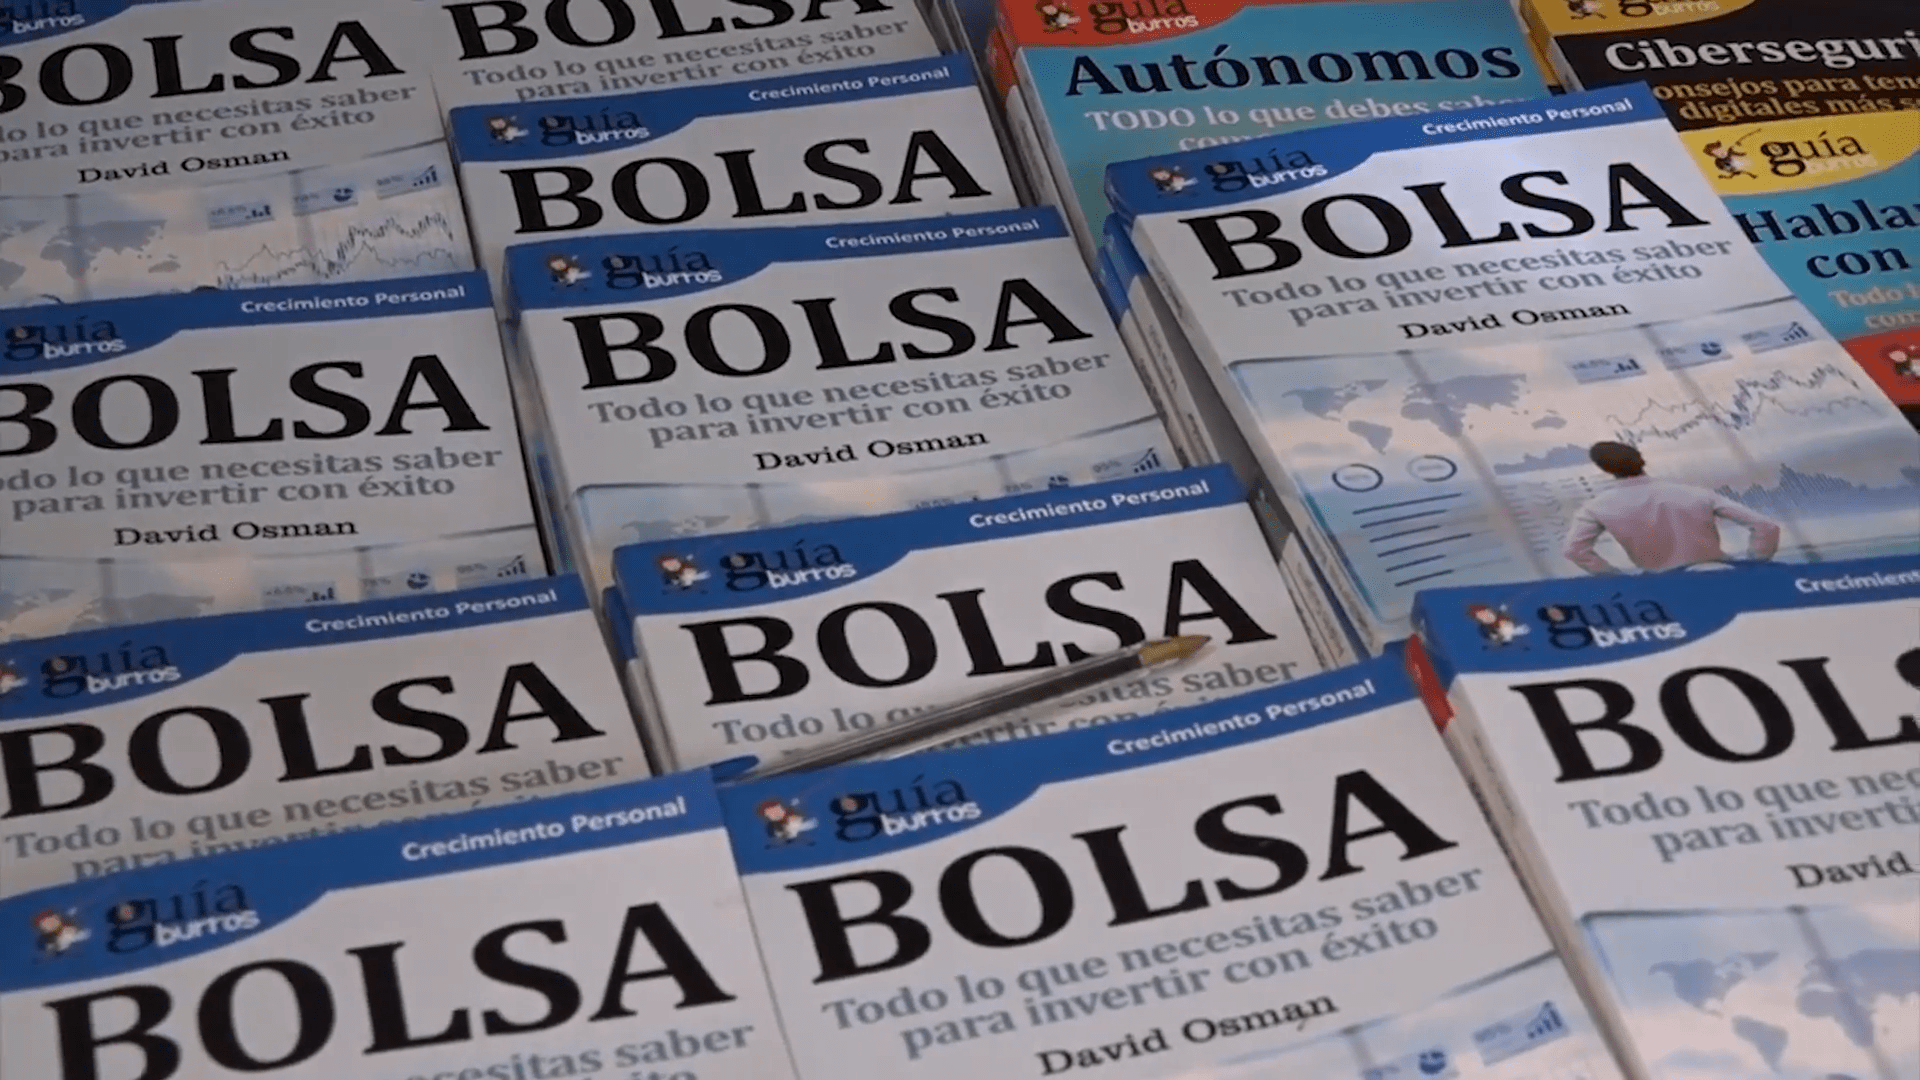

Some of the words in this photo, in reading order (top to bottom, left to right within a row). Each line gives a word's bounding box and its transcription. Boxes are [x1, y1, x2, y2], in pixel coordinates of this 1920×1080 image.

[12, 13, 85, 34] burros
[1126, 15, 1199, 34] burros
[0, 20, 405, 113] OLSA
[463, 68, 548, 88] Todo
[555, 60, 587, 78] lo
[600, 55, 656, 79] que
[664, 37, 811, 66] necesitas
[819, 18, 909, 44] saber
[515, 79, 591, 102] para
[600, 63, 724, 92] invertir
[732, 56, 790, 76] con
[798, 40, 876, 65] éxito
[1065, 44, 1521, 96] Autónomos
[1605, 30, 1920, 71] Ciberseguri
[748, 82, 863, 102] Crecimiento
[868, 66, 950, 89] Personal
[1653, 78, 1777, 100] onsejos
[1783, 76, 1861, 98] para
[1863, 74, 1920, 92] ten
[37, 121, 68, 140] lo
[78, 113, 144, 139] que
[152, 95, 302, 127] necesitas
[310, 84, 417, 112] saber
[79, 127, 212, 154] invertir
[220, 120, 282, 138] con
[291, 108, 374, 131] éxito
[1085, 109, 1196, 132] TODO
[1207, 105, 1239, 125] lo
[1249, 103, 1315, 128] que
[1324, 97, 1430, 121] debes
[1421, 115, 1542, 136] Crecimiento
[1547, 98, 1633, 120] Personal
[1679, 98, 1821, 123] digitales
[1828, 94, 1891, 113] más
[575, 125, 650, 146] burros
[1760, 130, 1869, 177] guía
[77, 160, 169, 184] David
[181, 149, 290, 172] Osman
[500, 130, 992, 233] BOLSA
[1247, 163, 1328, 188] burros
[825, 228, 948, 249] Crecimiento
[952, 219, 1041, 239] Personal
[1178, 162, 1710, 281] BOLSA
[643, 268, 723, 289] burros
[1222, 279, 1321, 308] Todo
[1330, 273, 1366, 295] lo
[1376, 265, 1450, 294] que
[1456, 246, 1626, 279] necesitas
[1635, 237, 1733, 263] saber
[1806, 247, 1910, 279] con
[241, 294, 369, 314] Crecimiento
[375, 285, 465, 305] Personal
[1288, 298, 1380, 327] para
[1387, 277, 1528, 312] invertir
[1539, 270, 1604, 291] con
[1612, 261, 1702, 284] éxito
[563, 278, 1093, 390] BOLSA
[1402, 312, 1503, 339] David
[1511, 303, 1632, 326] Osman
[44, 339, 127, 358] burros
[587, 399, 688, 424] Todo
[696, 392, 733, 415] lo
[741, 386, 814, 415] que
[824, 366, 997, 404] necesitas
[1005, 350, 1112, 378] saber
[648, 420, 739, 448] para
[749, 402, 893, 435] invertir
[903, 394, 970, 418] con
[978, 378, 1072, 408] éxito
[69, 466, 104, 487] lo
[116, 463, 190, 487] que
[201, 452, 383, 480] necesitas
[393, 447, 502, 469] saber
[755, 446, 858, 471] David
[867, 429, 990, 456] Osman
[13, 493, 105, 521] para
[115, 483, 268, 511] invertir
[278, 482, 348, 502] con
[359, 474, 456, 499] éxito
[969, 499, 1107, 530] Crecimiento
[1112, 480, 1210, 507] Personal
[114, 523, 218, 546] David
[232, 518, 359, 540] Osman
[768, 562, 857, 588] burros
[305, 604, 450, 633] Crecimiento
[455, 589, 557, 614] Personal
[680, 558, 1277, 706] BOLSA
[1592, 620, 1687, 648] burros
[86, 667, 181, 694] burros
[1182, 659, 1299, 694] saber
[713, 717, 823, 744] Todo
[833, 708, 876, 731] lo
[1107, 712, 1262, 757] Crecimiento
[1266, 678, 1376, 720] Personal
[1509, 647, 1920, 784] BOL
[0, 661, 606, 818] BOLSA
[5, 829, 121, 859] Todo
[133, 817, 175, 843] lo
[187, 806, 271, 838] que
[283, 777, 490, 823] necesitas
[502, 754, 624, 792] saber
[830, 774, 968, 842] guía
[880, 800, 982, 836] burros
[1569, 793, 1686, 829] Todo
[1695, 784, 1744, 814] lo
[1754, 777, 1841, 813] que
[402, 821, 565, 862] Crecimiento
[571, 797, 687, 832] Personal
[1650, 817, 1763, 863] para
[1766, 795, 1920, 840] inverti
[785, 768, 1458, 985] BOLSA
[1785, 850, 1914, 889] David
[105, 881, 250, 954] guía
[155, 909, 261, 947] burros
[822, 988, 949, 1031] Todo
[959, 973, 1003, 1005] lo
[1019, 957, 1107, 1001] que
[1120, 906, 1344, 973] necesitas
[1351, 863, 1483, 916] saber
[45, 902, 737, 1080] BOLSA
[901, 1010, 1014, 1059] para
[1025, 967, 1207, 1029] invertir
[1222, 943, 1314, 985] con
[1322, 912, 1439, 963] éxito
[614, 1024, 755, 1068] saber
[1038, 1027, 1170, 1077] David
[1181, 994, 1340, 1042] Osman
